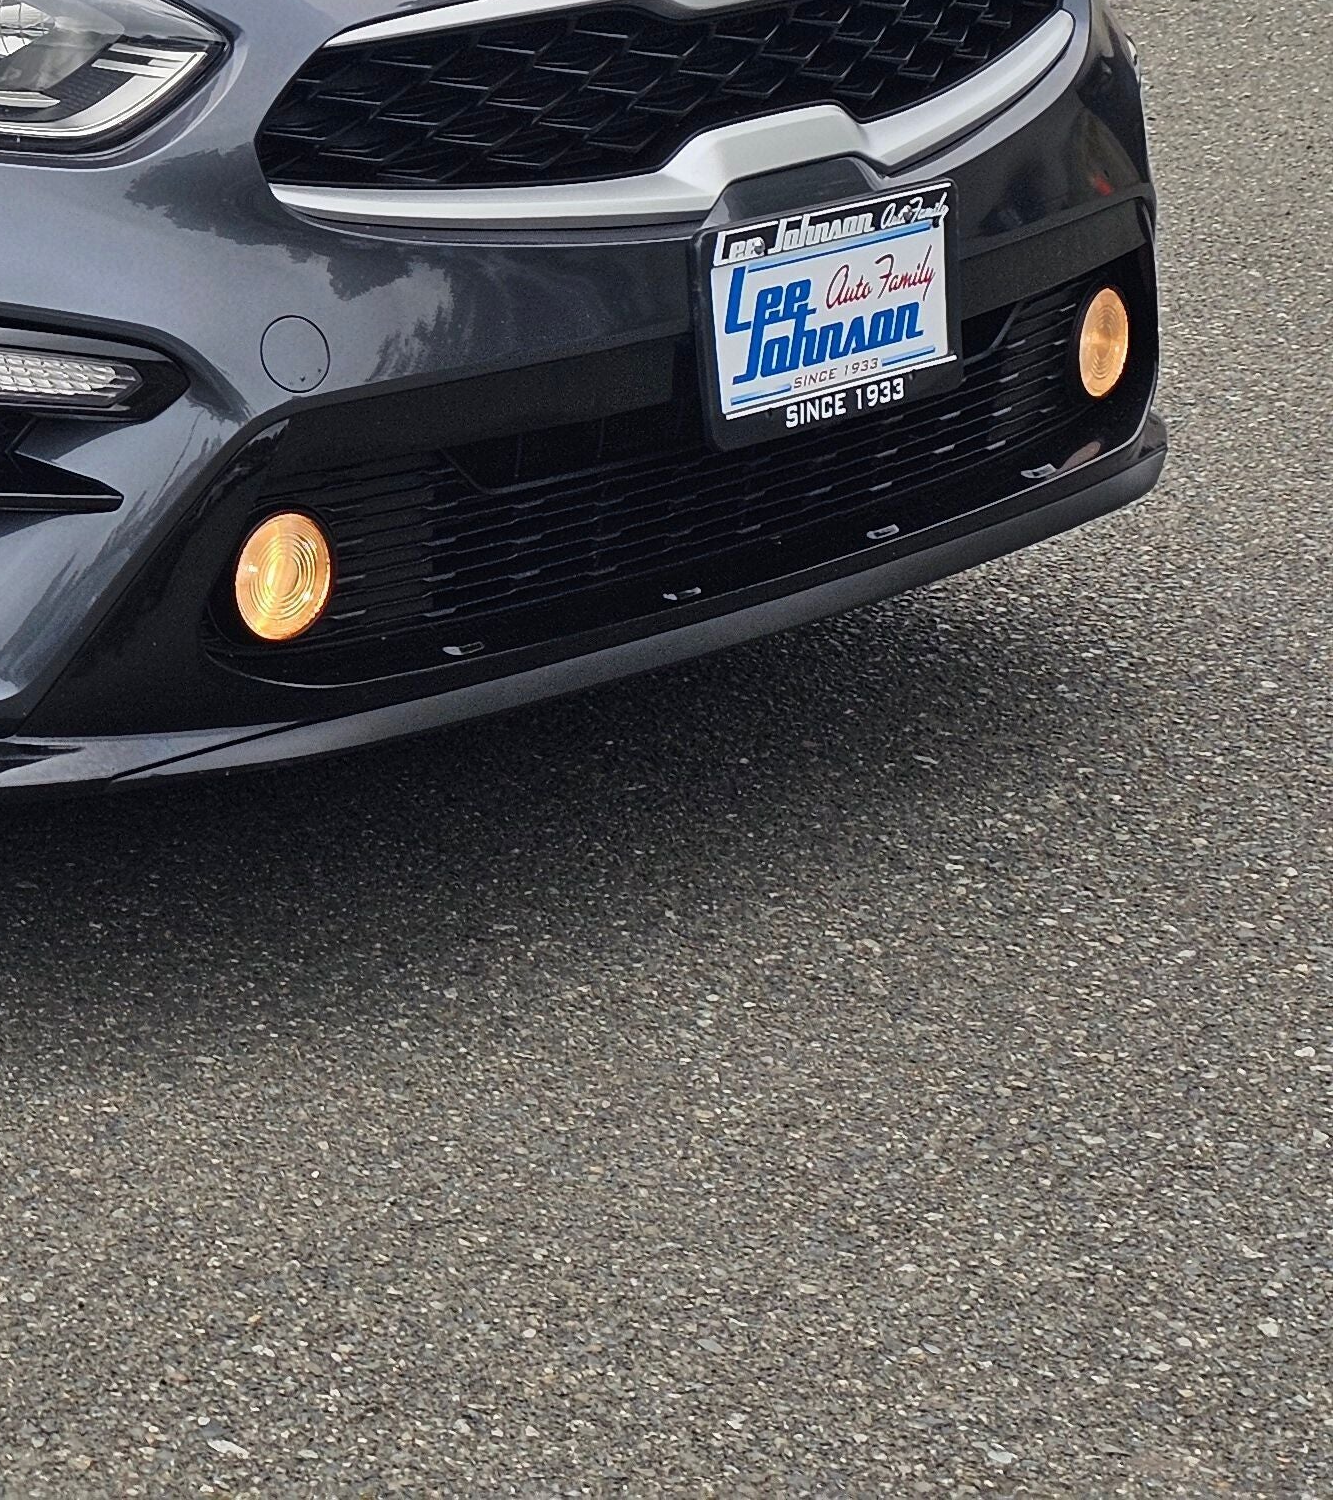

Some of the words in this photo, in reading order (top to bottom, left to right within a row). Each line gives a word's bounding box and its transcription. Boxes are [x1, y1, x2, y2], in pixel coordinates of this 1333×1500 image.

[713, 230, 765, 267] Lee
[767, 213, 875, 255] Johnson
[724, 266, 817, 335] Lee
[825, 264, 873, 310] Auto
[875, 244, 936, 301] Family
[732, 302, 923, 386] Johnson
[793, 367, 837, 389] SINCE
[844, 357, 878, 377] 1933
[785, 395, 847, 429] SINCE
[855, 377, 905, 410] 1933
